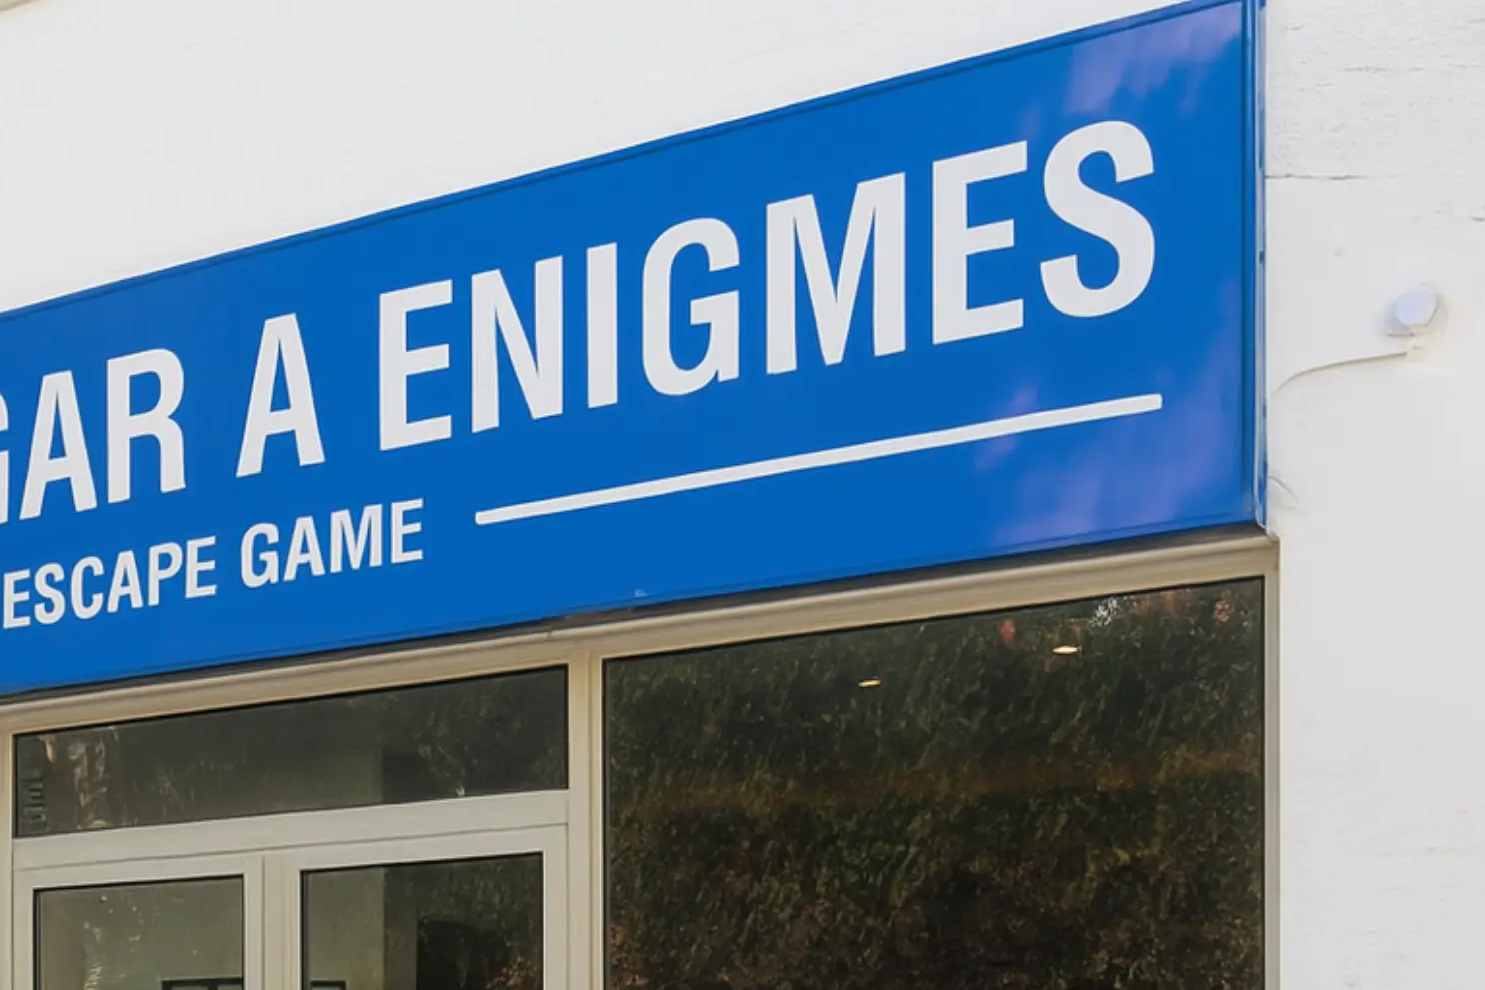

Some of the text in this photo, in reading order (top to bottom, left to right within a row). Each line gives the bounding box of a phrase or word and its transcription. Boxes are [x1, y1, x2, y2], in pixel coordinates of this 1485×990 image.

[235, 313, 326, 478] A
[379, 120, 1156, 451] ENIGMES
[3, 498, 424, 629] ESCAPE GAME
